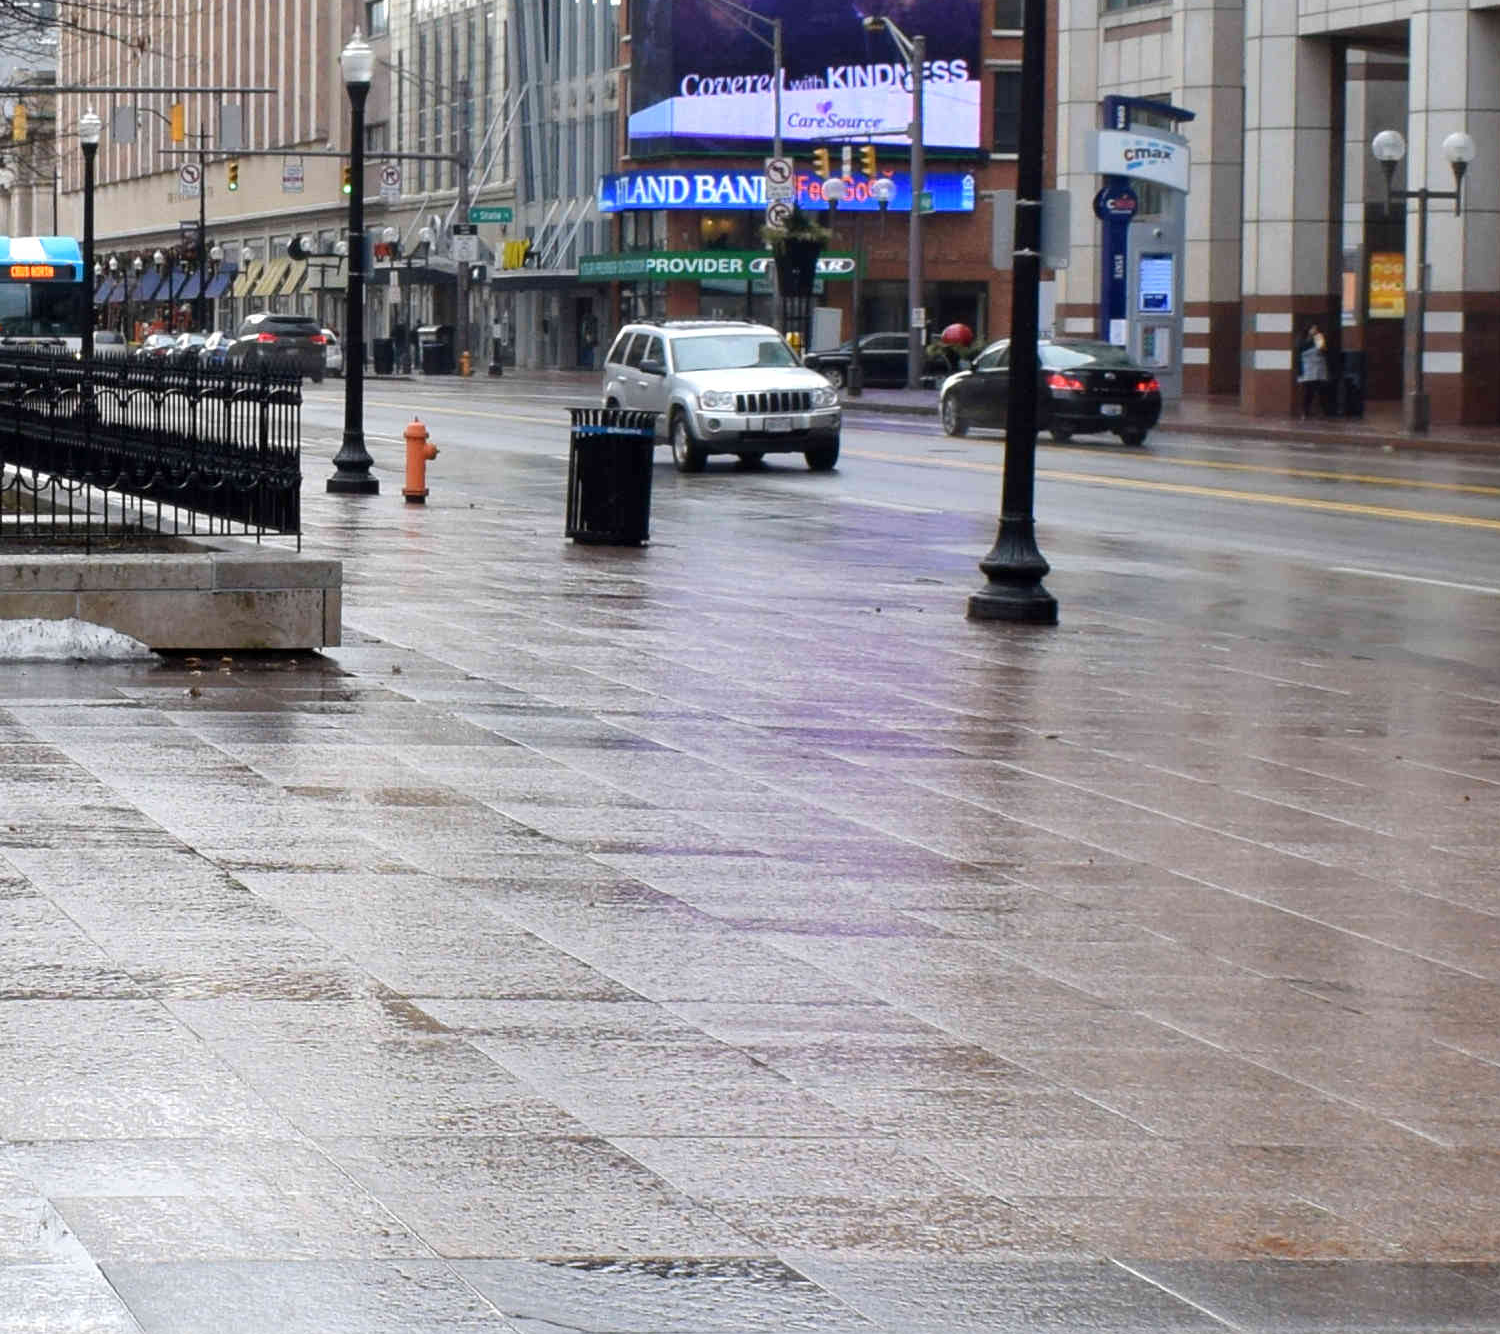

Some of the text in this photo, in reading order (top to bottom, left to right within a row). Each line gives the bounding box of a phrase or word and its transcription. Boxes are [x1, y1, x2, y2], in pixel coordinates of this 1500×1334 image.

[681, 68, 788, 96] Covered
[790, 75, 824, 91] with
[787, 113, 883, 128] CareSource
[1124, 148, 1172, 161] cmax
[647, 258, 743, 273] PROVIDER
